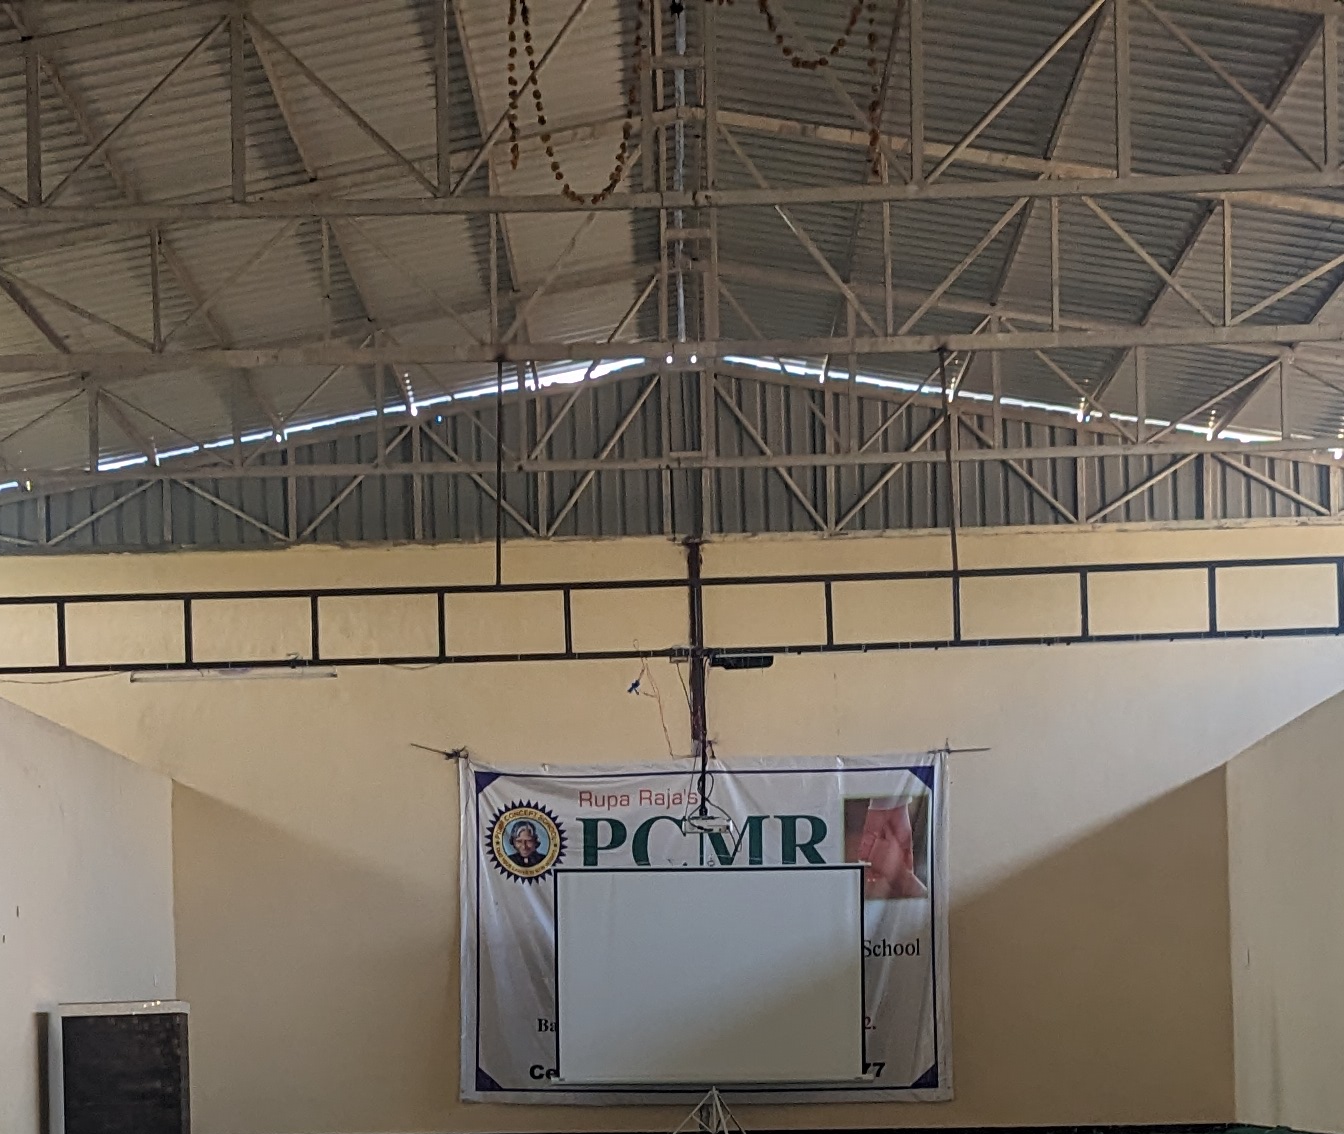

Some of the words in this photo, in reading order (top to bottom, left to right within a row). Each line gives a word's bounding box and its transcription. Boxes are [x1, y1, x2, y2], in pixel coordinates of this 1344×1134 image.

[578, 790, 630, 811] Rupa
[639, 788, 698, 810] Raja's
[576, 814, 827, 867] PCMR
[864, 938, 921, 958] School
